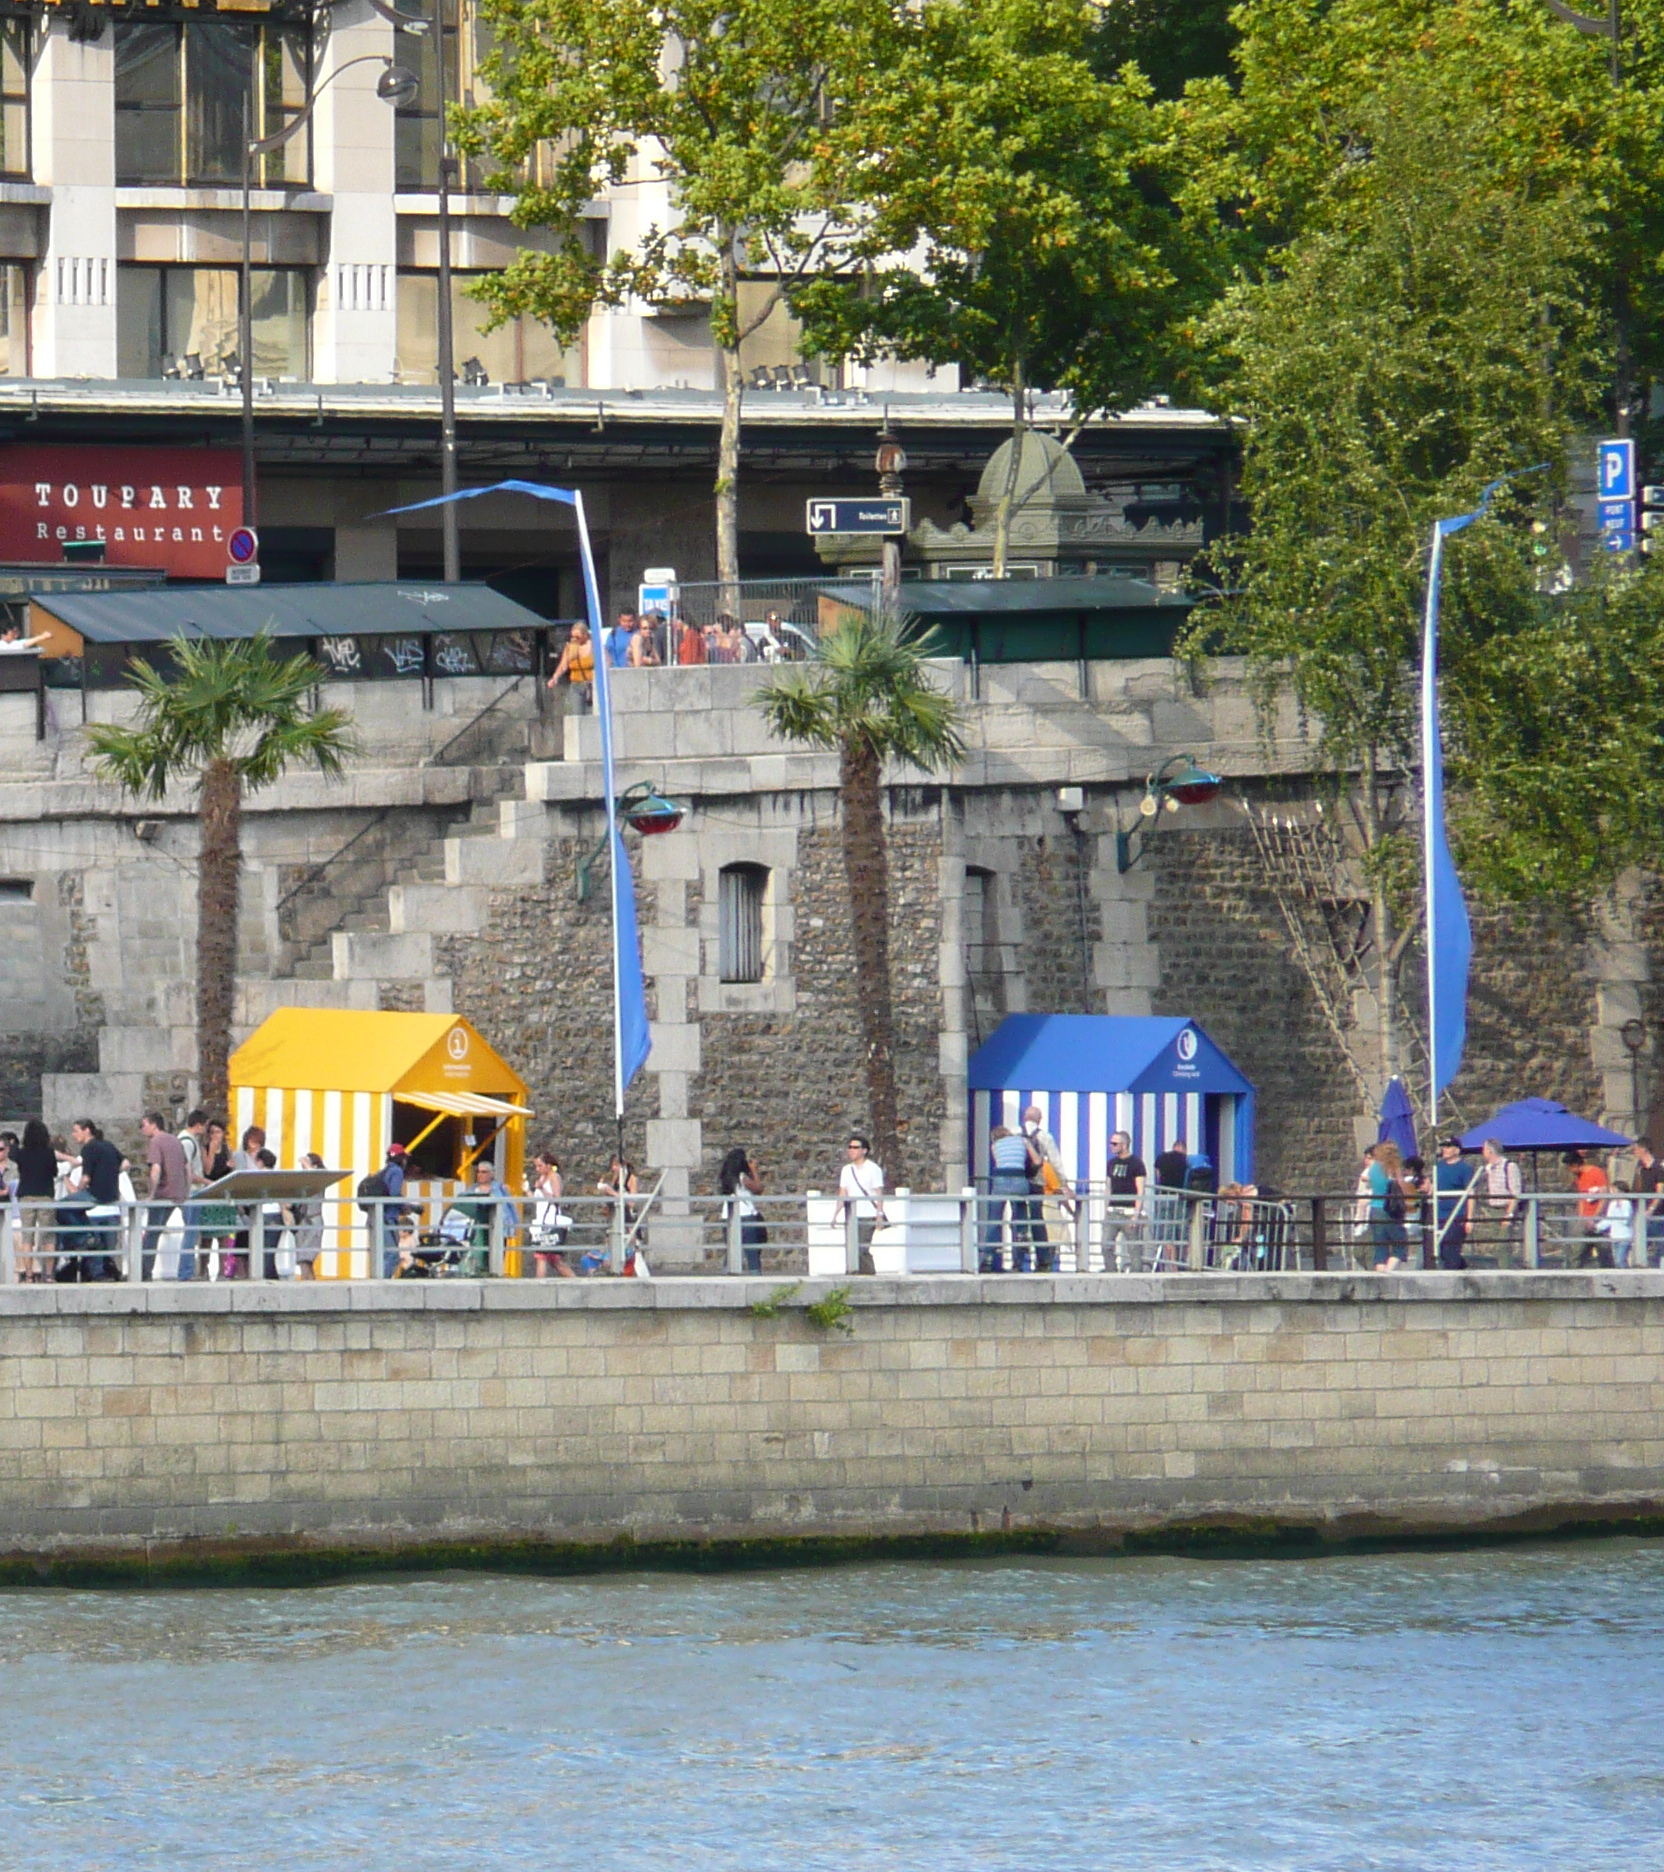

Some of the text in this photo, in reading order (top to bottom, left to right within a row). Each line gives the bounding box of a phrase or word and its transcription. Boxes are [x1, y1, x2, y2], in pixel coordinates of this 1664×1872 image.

[1606, 452, 1623, 489] P
[35, 483, 223, 509] TOUPARY
[36, 522, 224, 542] Restaurant
